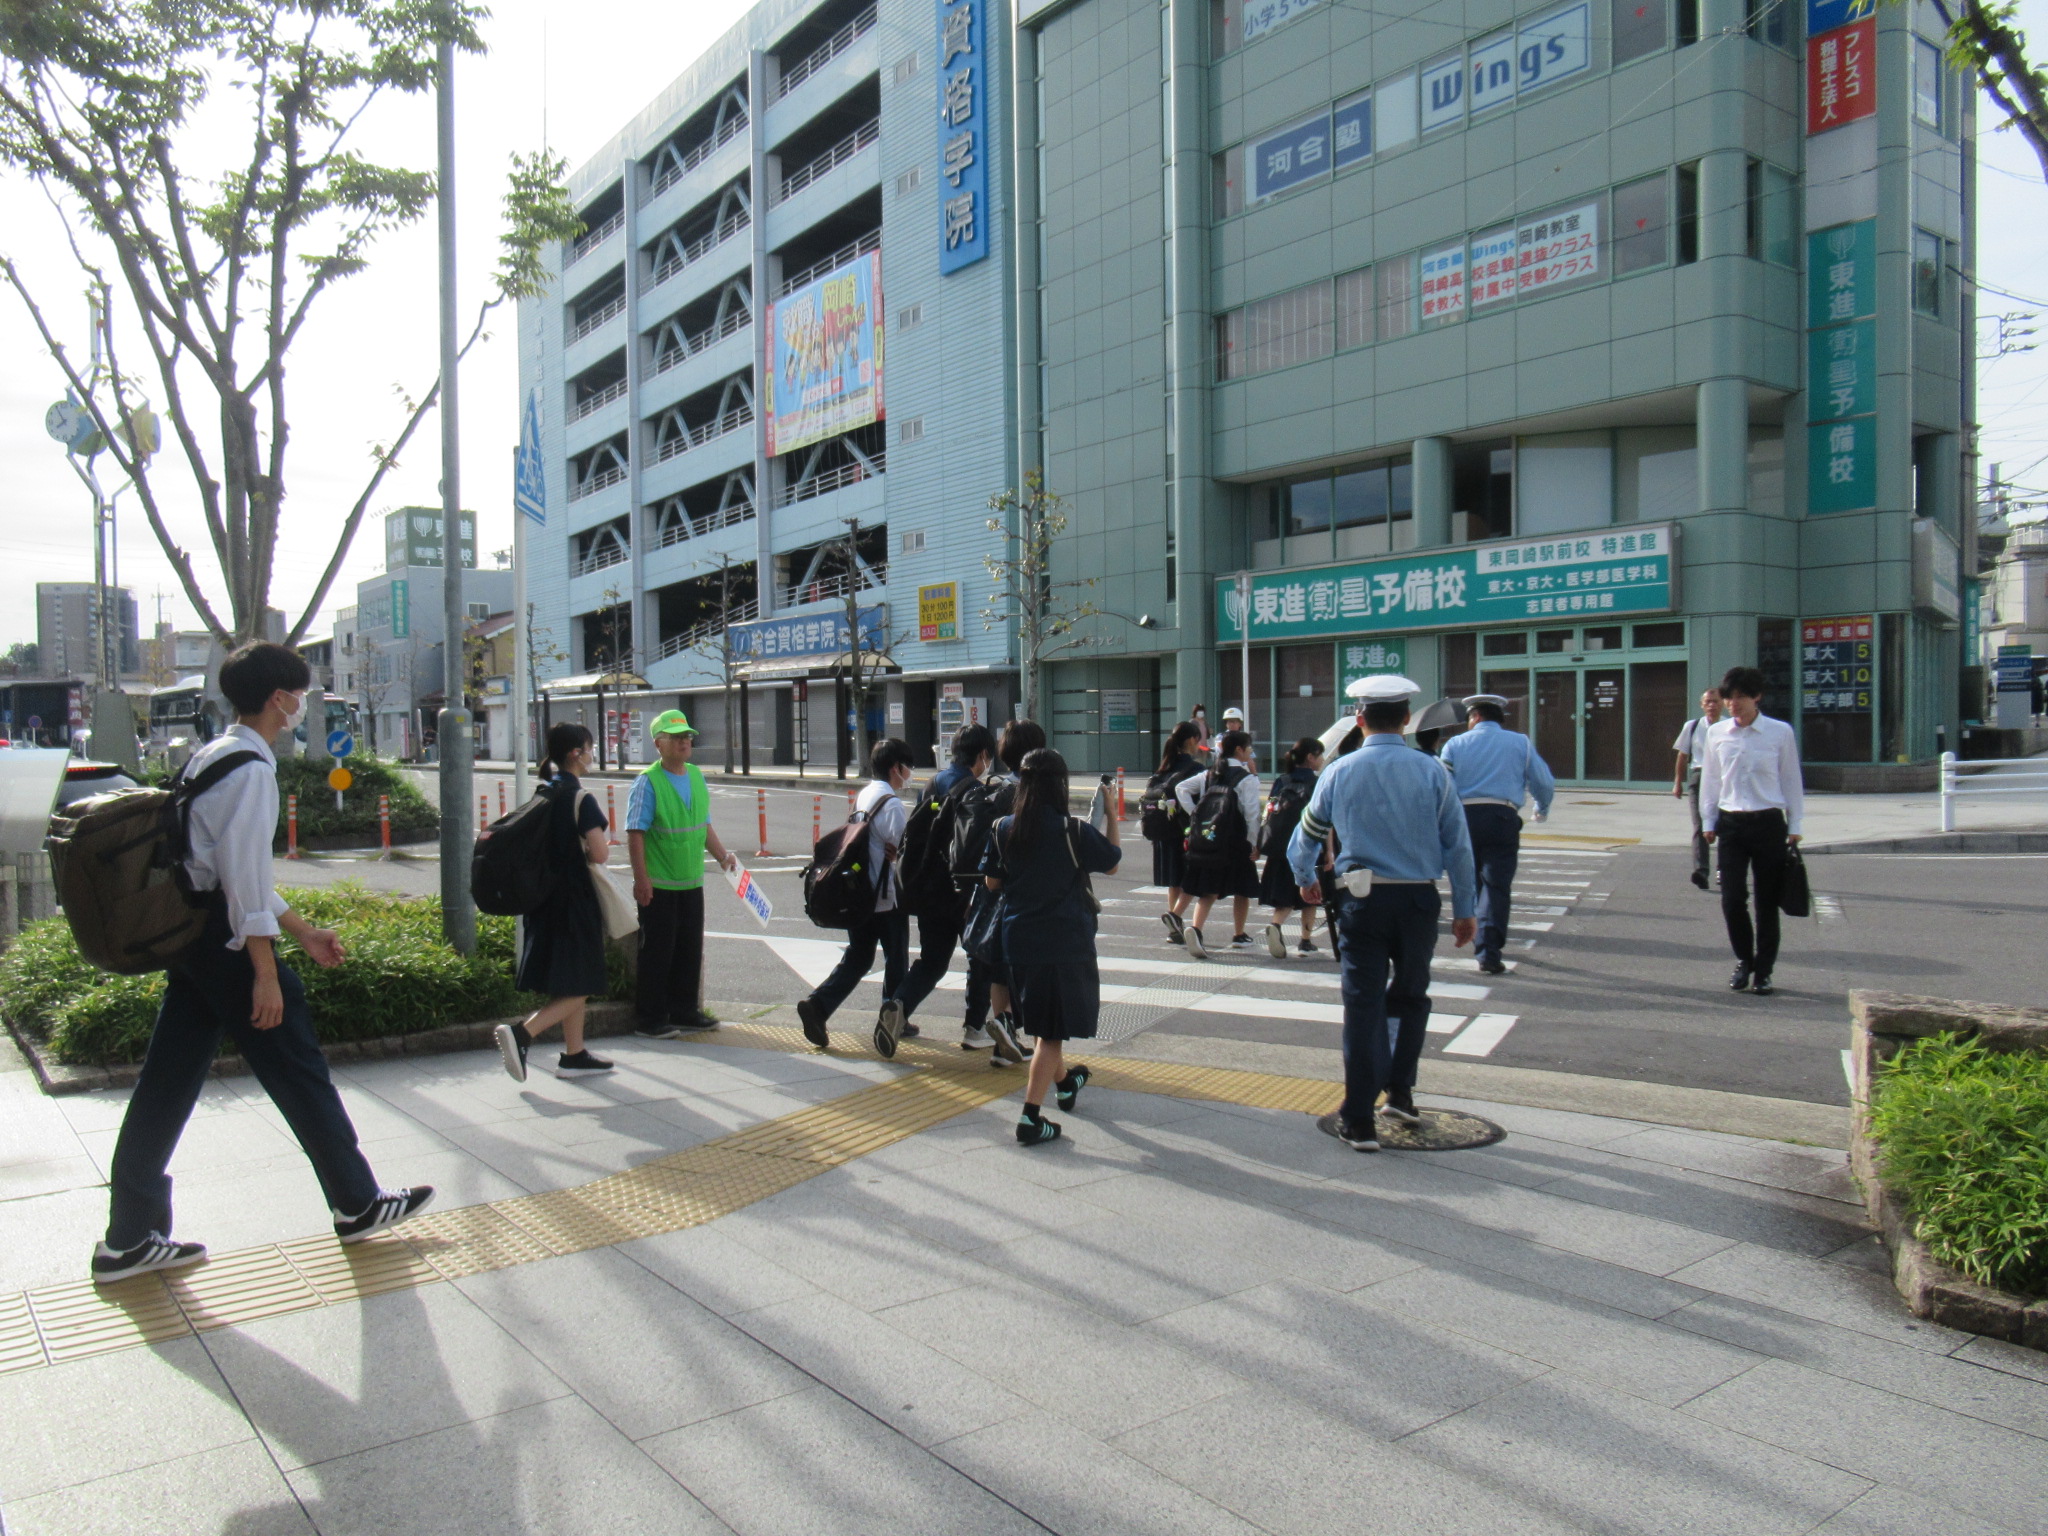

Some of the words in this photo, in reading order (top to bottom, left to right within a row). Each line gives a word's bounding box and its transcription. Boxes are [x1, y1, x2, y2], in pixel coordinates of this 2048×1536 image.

[1820, 38, 1838, 123] 税理士法人
[1844, 31, 1860, 98] フレスコ
[942, 0, 974, 252] 資格学院
[1266, 118, 1361, 180] 河合塾
[1519, 213, 1580, 248] 岡崎教室
[1828, 260, 1858, 484] 東進衛星予備校
[1488, 540, 1591, 568] 東岡崎駅前校
[1602, 532, 1657, 555] 特進館
[1253, 564, 1468, 626] 東進衛星予備校
[1487, 563, 1658, 594] 東大・京大・医学部医学科
[1526, 593, 1614, 614] 志望者専用館
[751, 619, 835, 656] 総合資格学院
[1803, 644, 1836, 661] 東大
[1857, 643, 1869, 658] 5
[1346, 643, 1401, 669] 東進の
[1803, 667, 1836, 685] 京大
[1803, 692, 1854, 709] 医学部
[1857, 692, 1869, 706] 5
